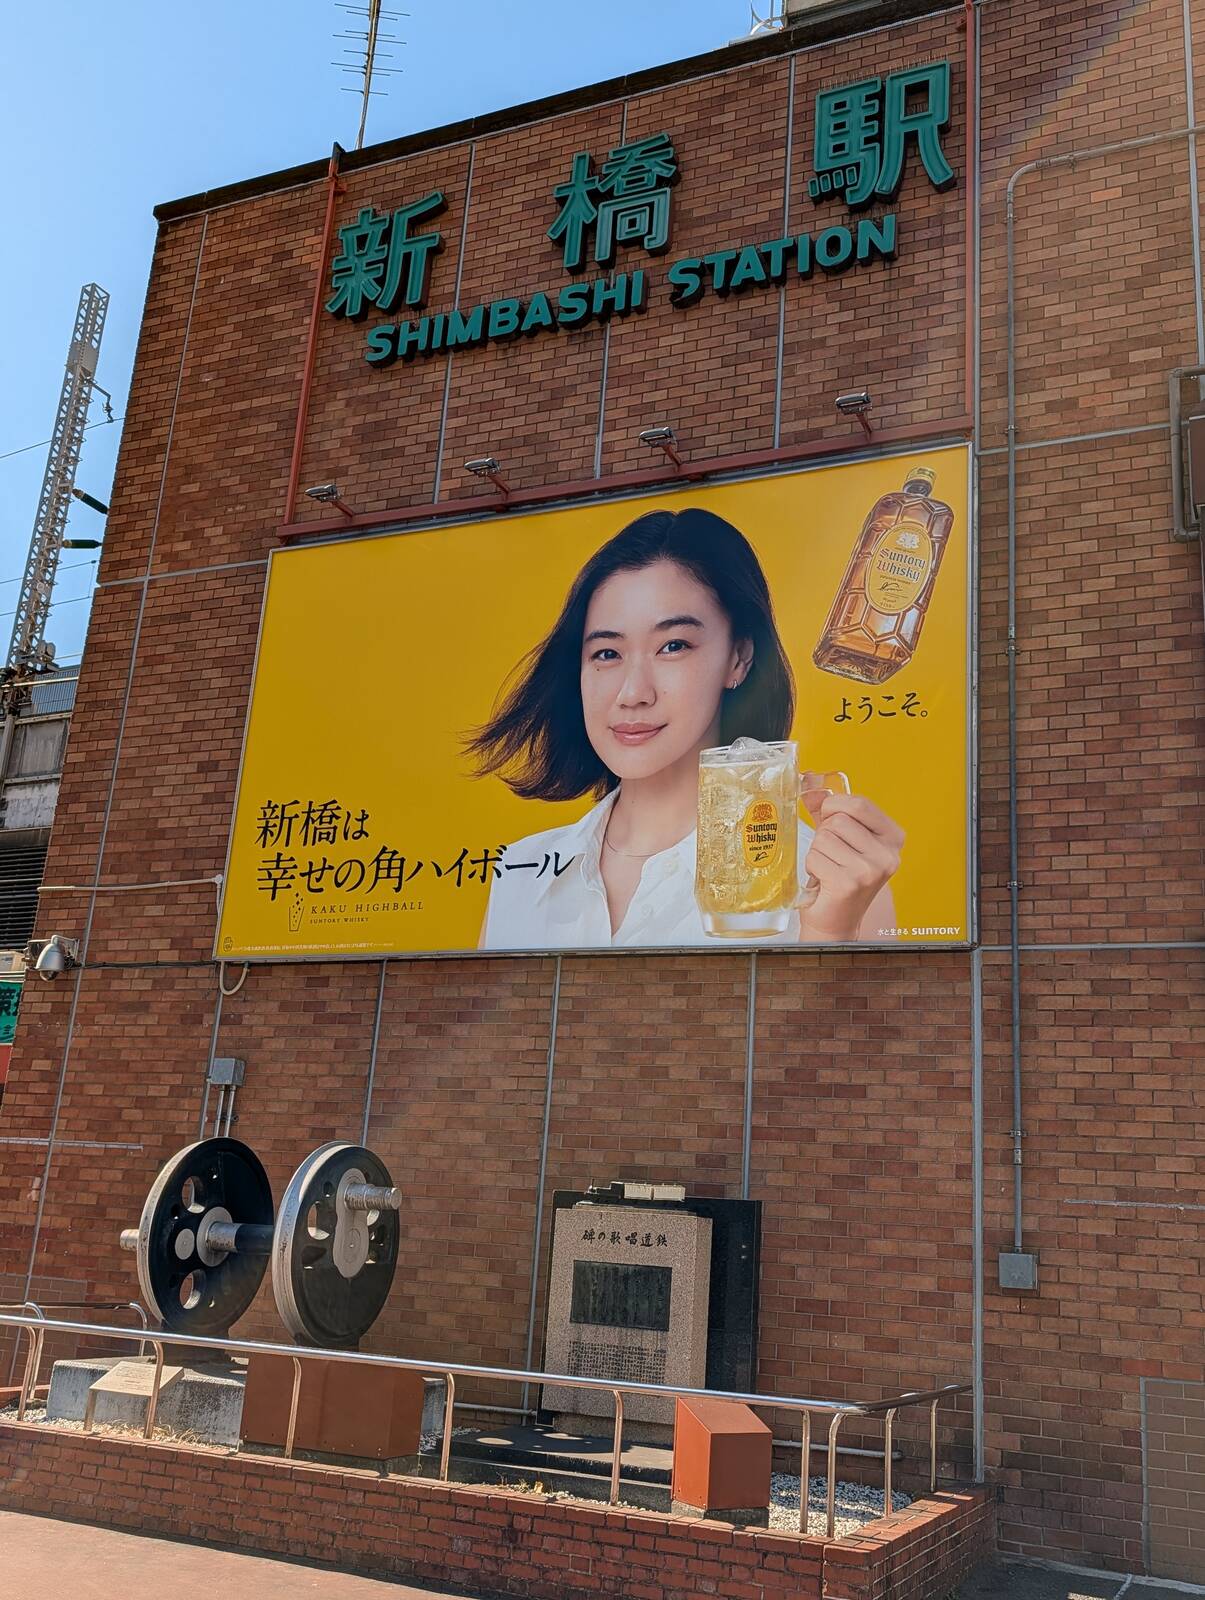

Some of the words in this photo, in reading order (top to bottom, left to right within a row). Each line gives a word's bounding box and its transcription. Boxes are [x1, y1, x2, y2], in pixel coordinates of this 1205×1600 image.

[325, 59, 957, 319] 新橋駅
[365, 269, 648, 366] SHIMBASHI
[668, 214, 898, 306] STATION
[880, 548, 926, 569] Suntory
[877, 560, 920, 581] Whisky
[834, 692, 928, 724] ようこそ。
[255, 799, 370, 849] 新橋は
[745, 823, 777, 833] Suntory
[746, 832, 776, 843] Whisky
[256, 845, 575, 902] 幸せの角ハイボール
[311, 905, 347, 914] KAKU
[355, 902, 424, 912] HIGHBALL
[878, 928, 909, 936] 水と生きる
[911, 926, 961, 935] SUNTORY
